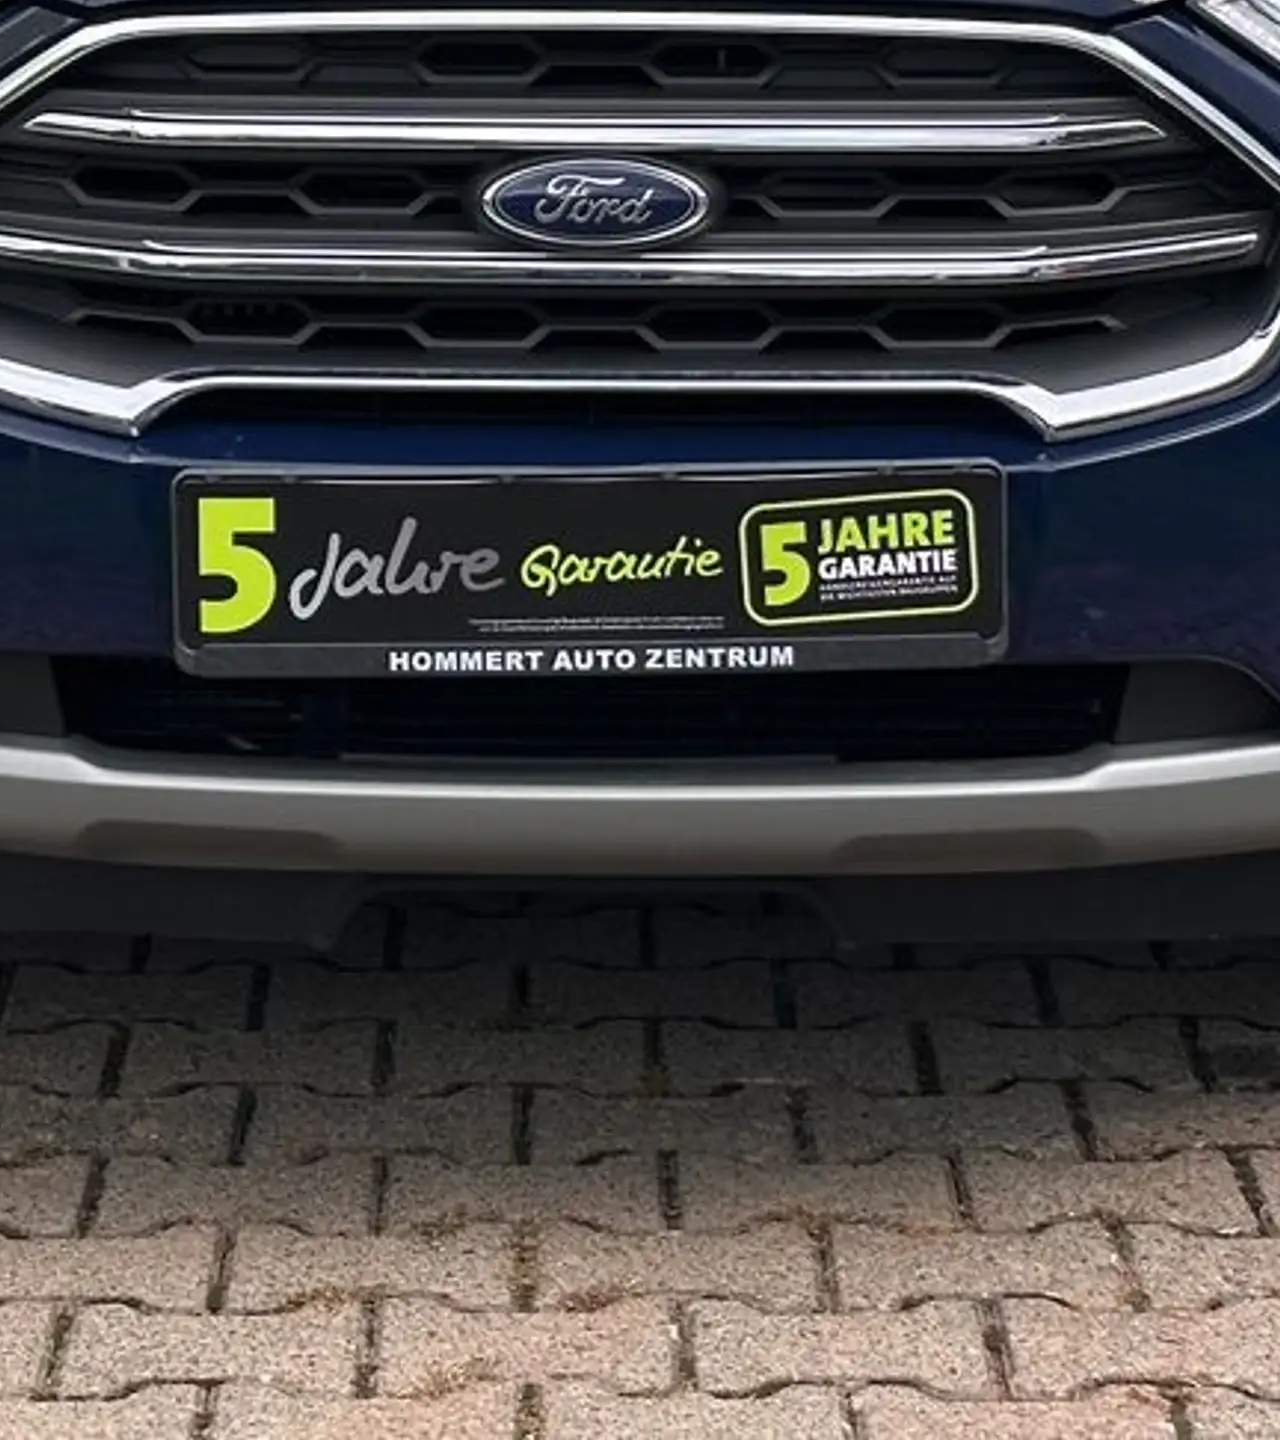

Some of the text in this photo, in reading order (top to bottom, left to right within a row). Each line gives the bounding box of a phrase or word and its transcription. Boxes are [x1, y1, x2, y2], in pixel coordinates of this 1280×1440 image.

[534, 174, 654, 224] Ford
[198, 497, 277, 634] 5
[289, 516, 505, 620] Jahre
[760, 509, 955, 606] 5 JAHRE
[818, 548, 959, 580] GARANTIE
[389, 645, 795, 672] HOMMERT AUTO ZENTRUM
